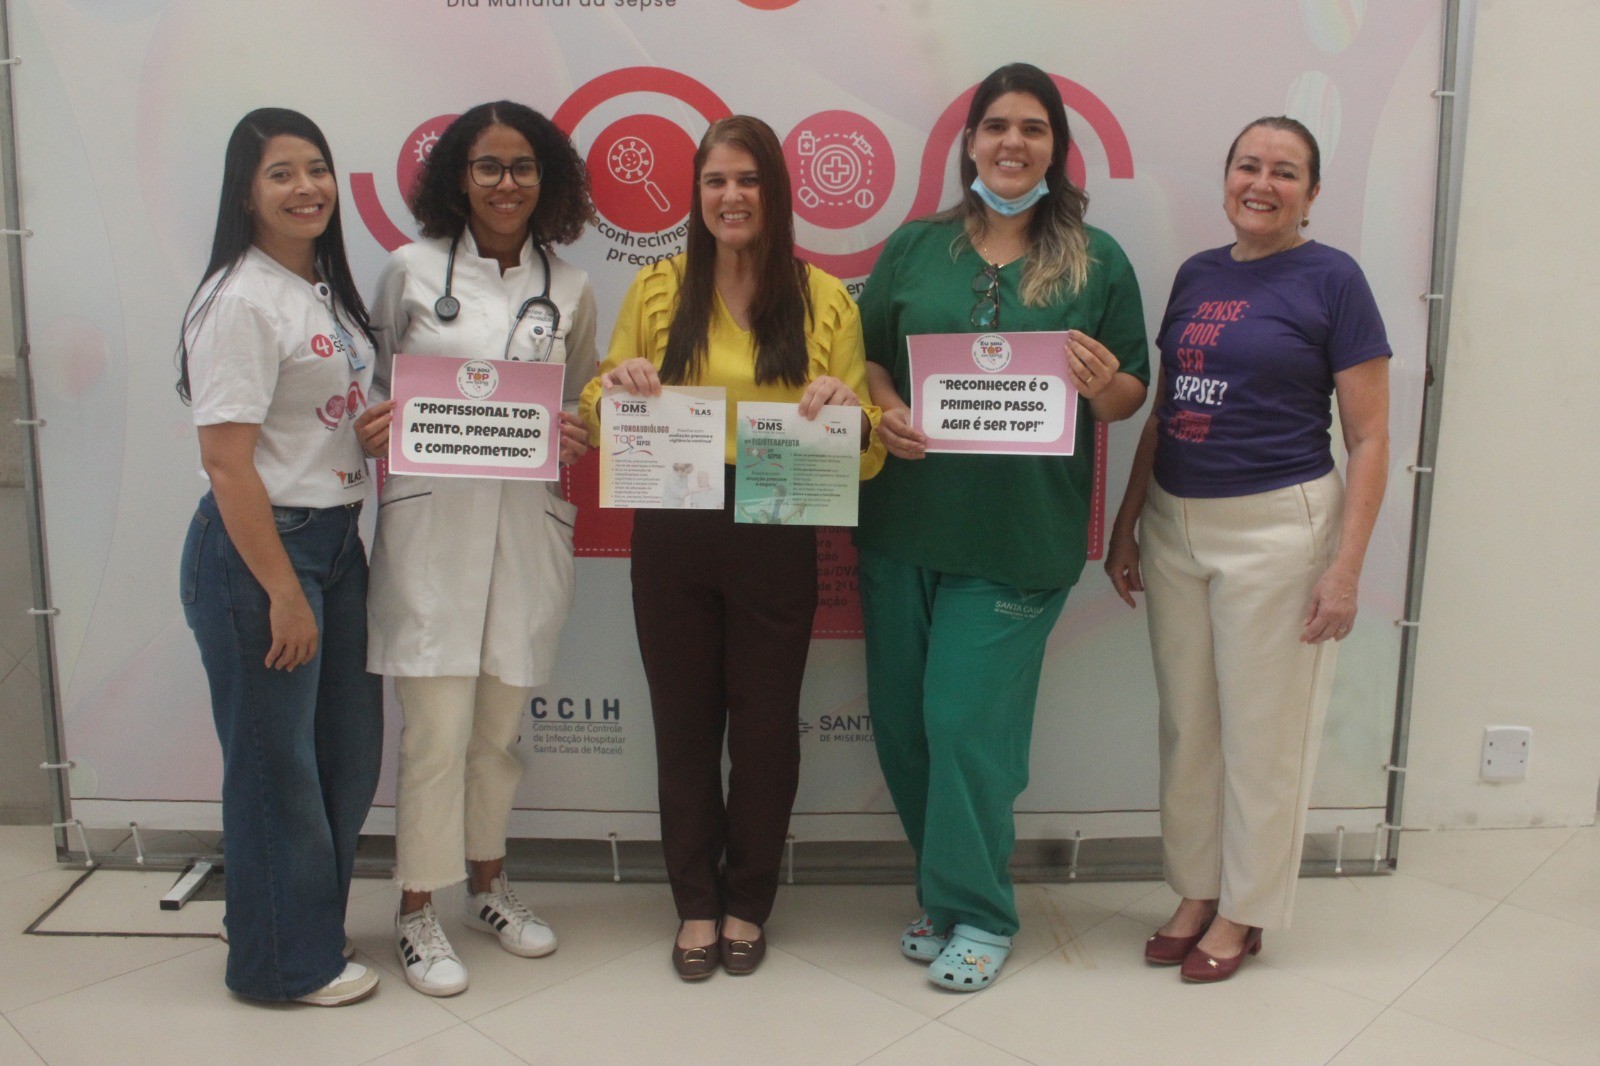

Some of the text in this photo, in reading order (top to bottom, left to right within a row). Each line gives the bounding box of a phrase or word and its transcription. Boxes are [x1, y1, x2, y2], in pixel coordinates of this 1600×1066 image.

[1192, 300, 1250, 322] PENSE:
[1179, 322, 1226, 346] PODE
[316, 337, 330, 356] 4
[1176, 347, 1205, 374] SER
[1173, 375, 1228, 406] SEPSE?
[622, 404, 647, 413] DMS
[758, 421, 783, 431] DMS
[941, 419, 970, 430] AGIR
[830, 427, 847, 435] ILAS
[613, 434, 636, 445] TOP
[532, 723, 623, 733] Comissão de Controle
[820, 715, 872, 731] SANT
[533, 734, 626, 745] de Infecção Hospitalar
[533, 744, 623, 754] Santa Casa de Maceió
